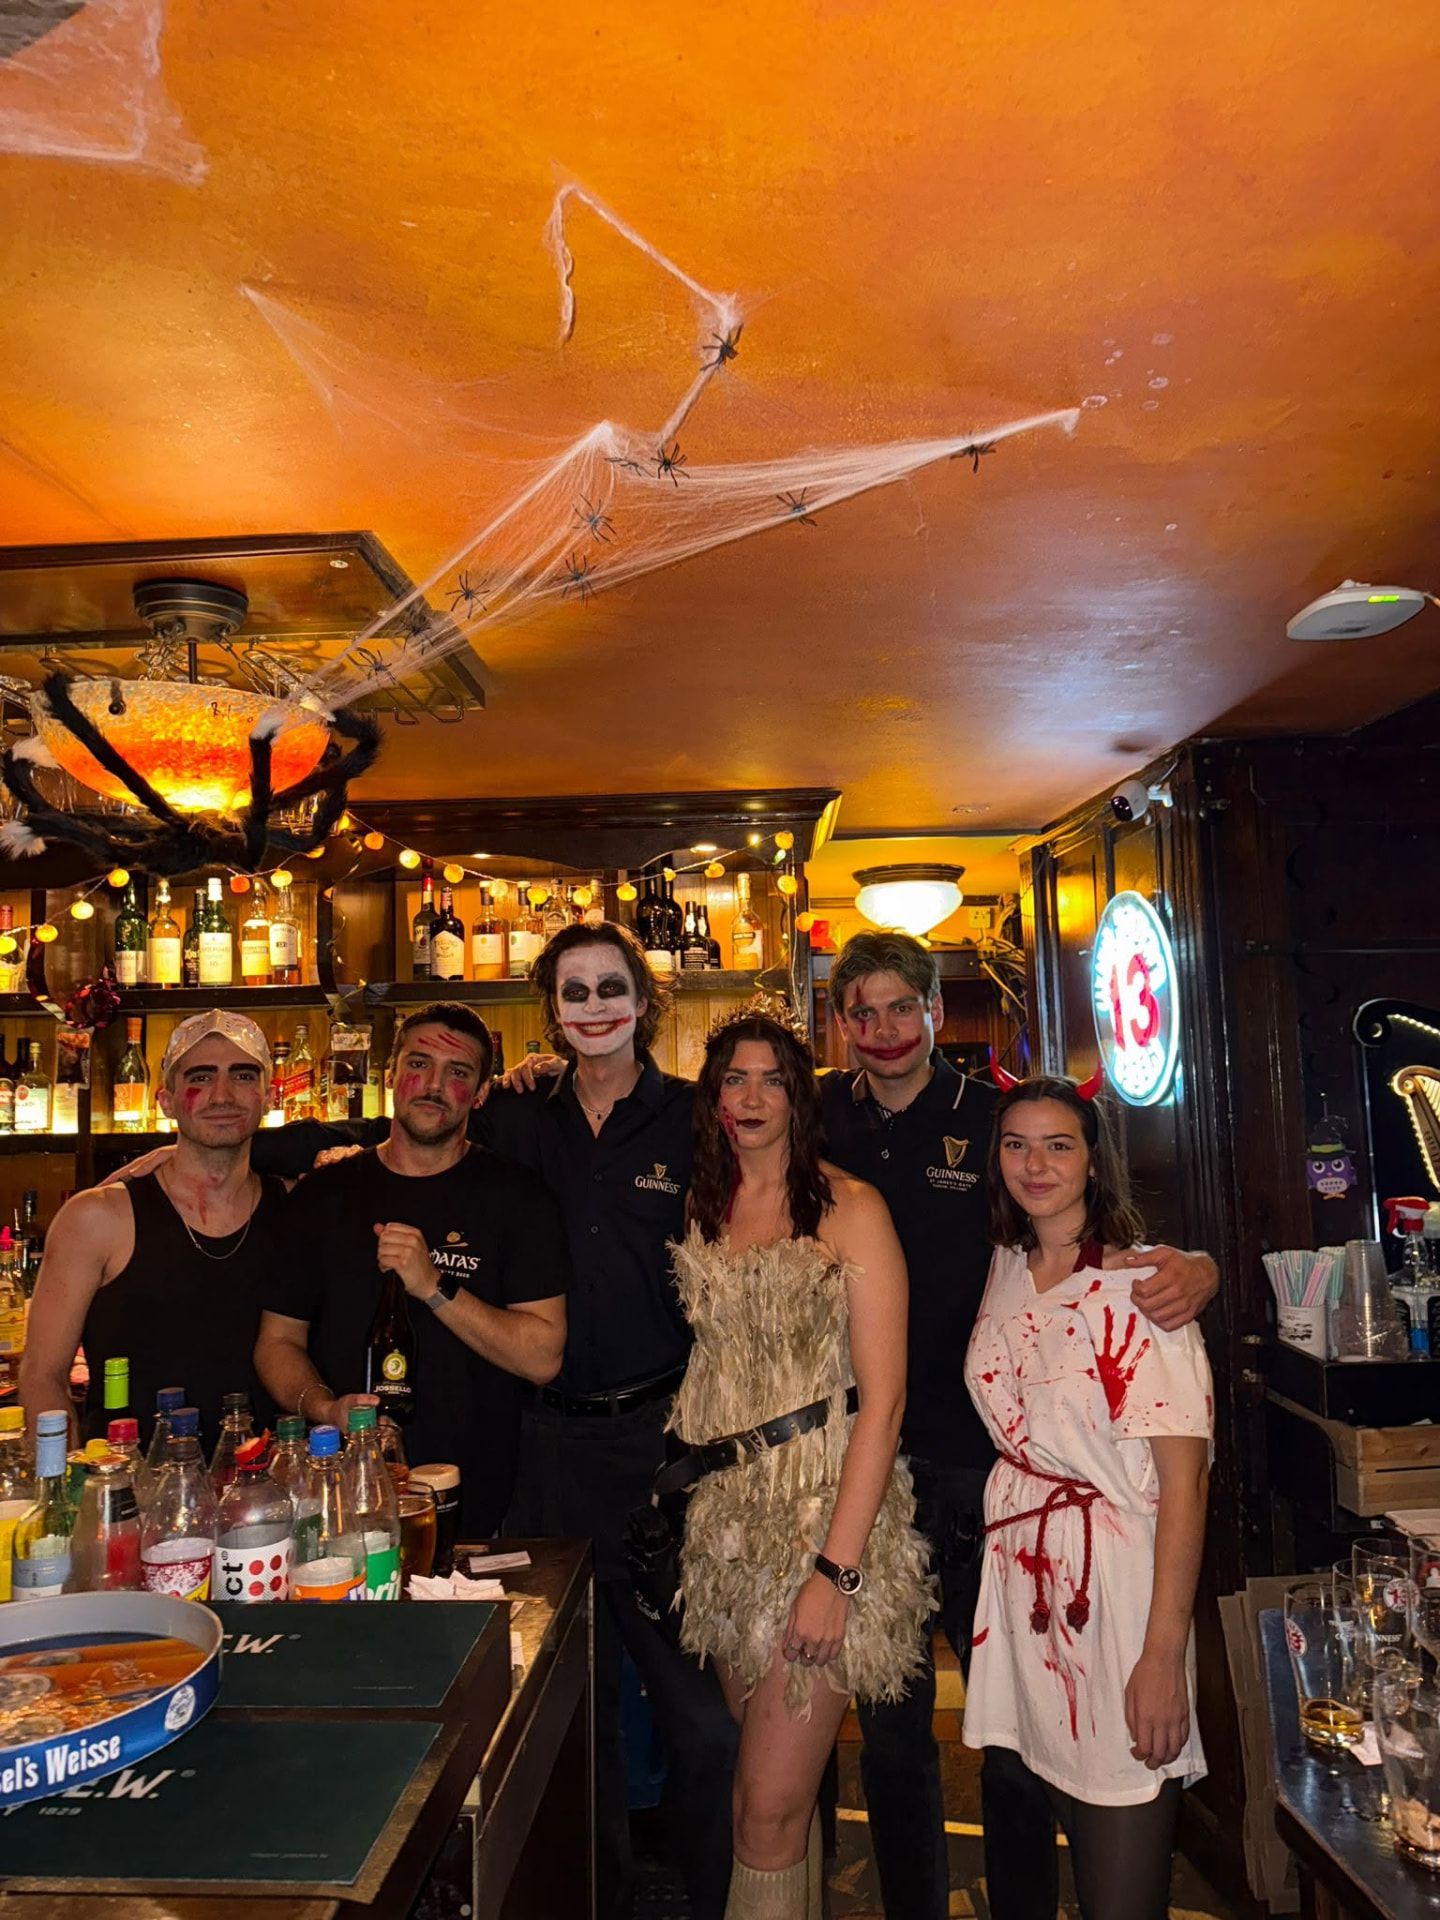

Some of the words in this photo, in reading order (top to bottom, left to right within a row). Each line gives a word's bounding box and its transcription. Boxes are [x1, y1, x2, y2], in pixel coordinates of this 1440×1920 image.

[1109, 952, 1158, 1052] 13
[635, 1175, 679, 1195] GUINNESS
[926, 1166, 977, 1184] GUINNESS
[45, 1735, 121, 1785] Weisse
